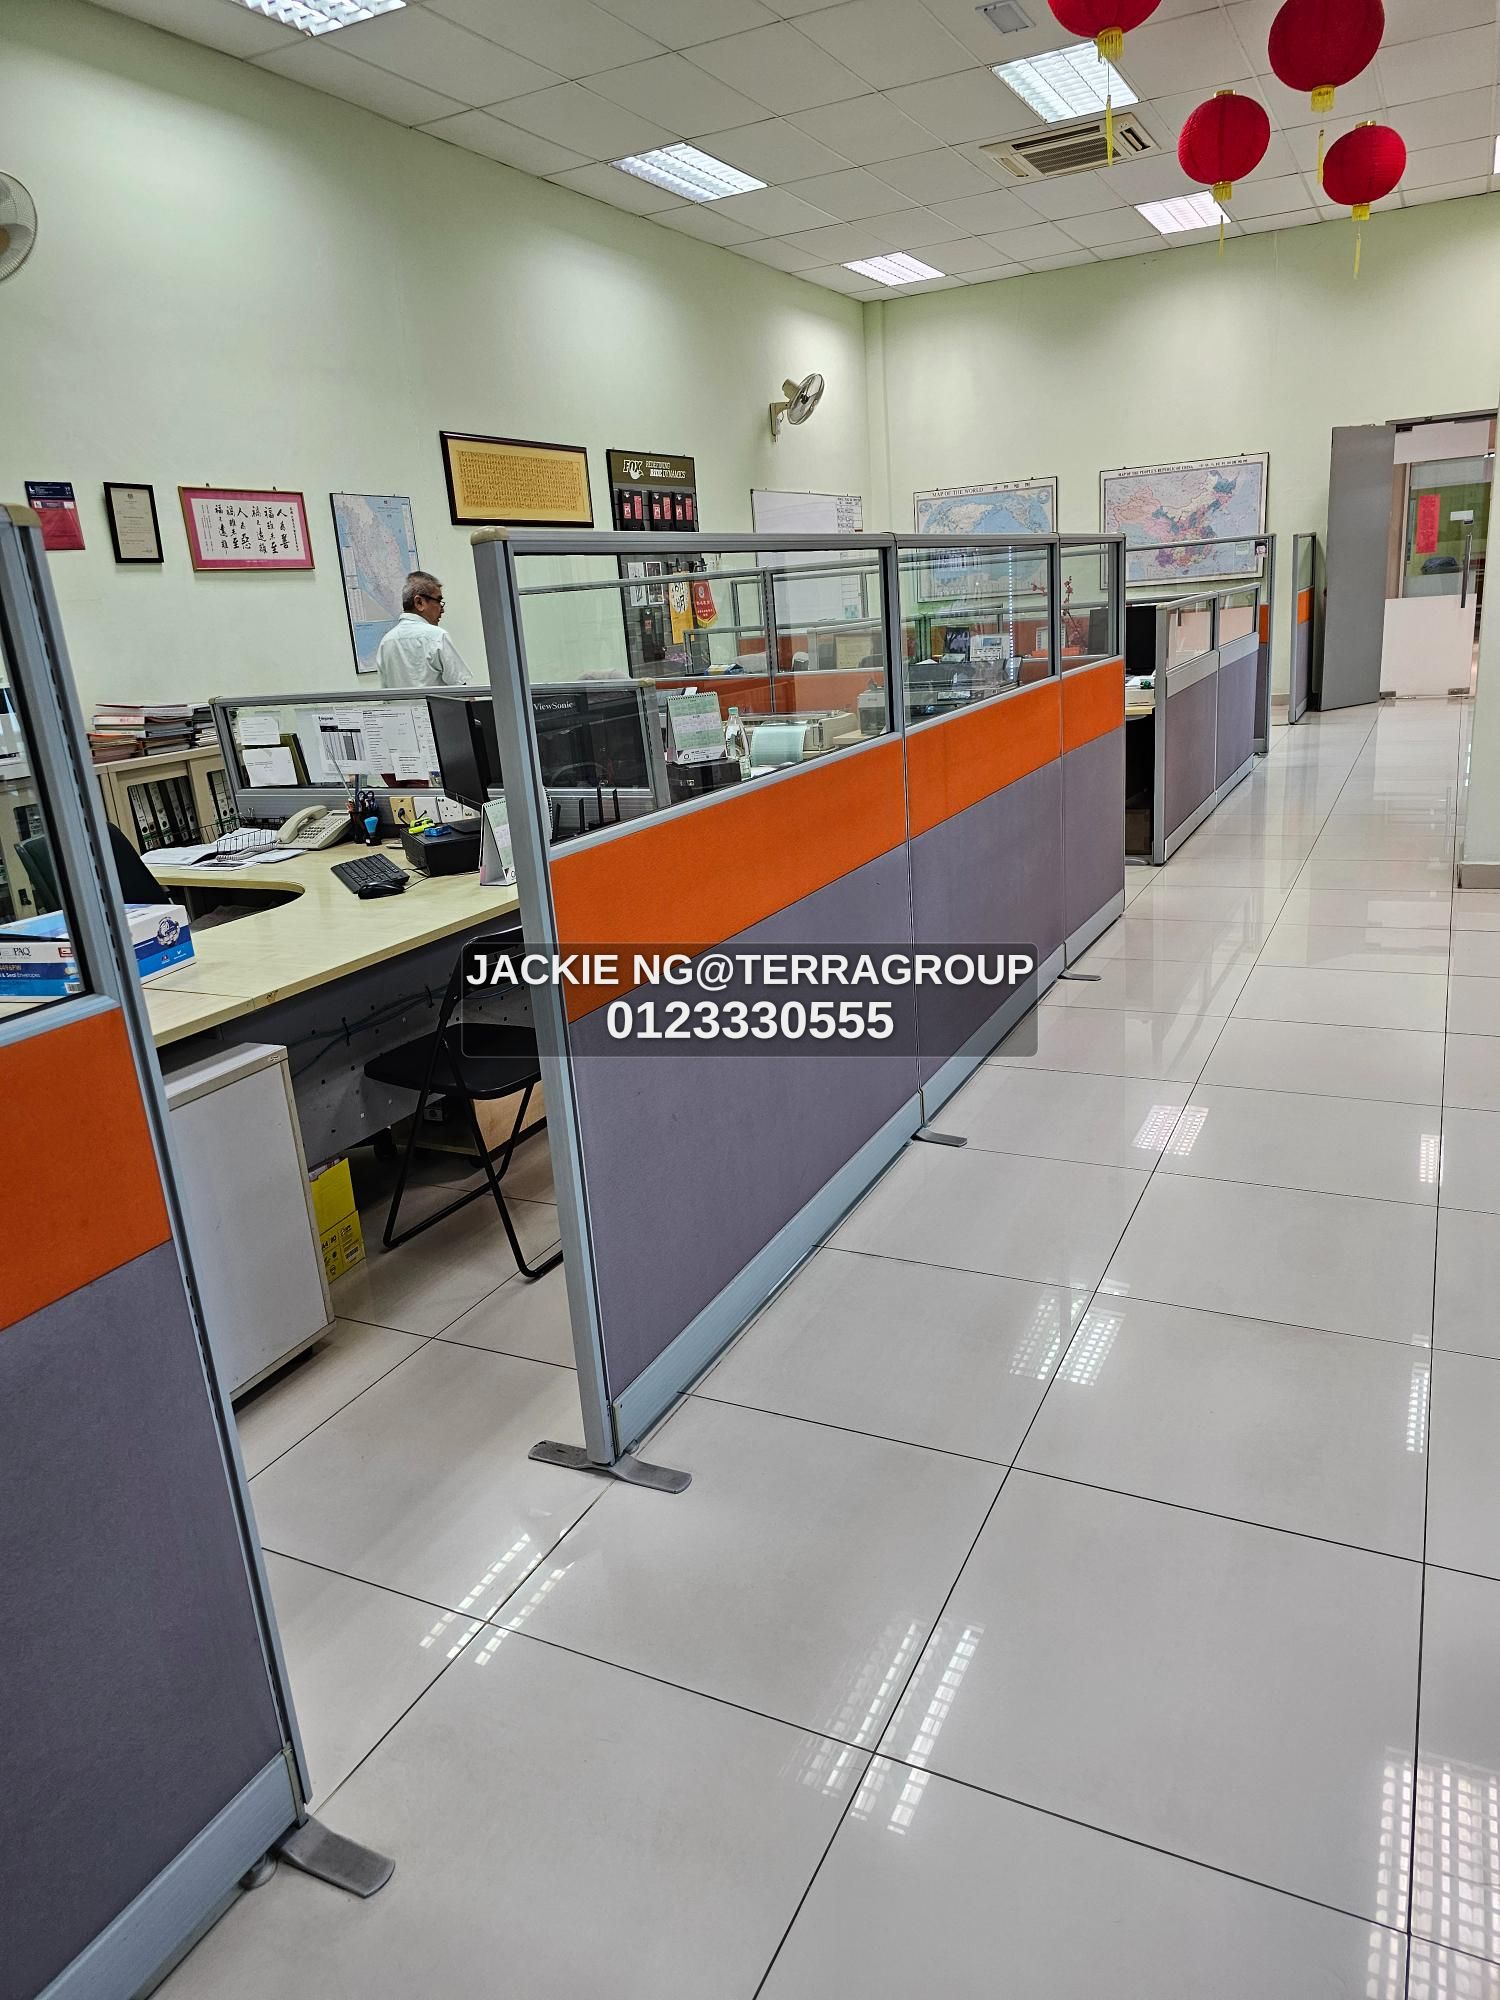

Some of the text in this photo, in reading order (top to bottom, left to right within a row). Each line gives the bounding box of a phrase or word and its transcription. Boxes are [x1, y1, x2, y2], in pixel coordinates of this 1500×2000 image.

[623, 459, 643, 475] FOX
[533, 700, 574, 710] ViewSonic
[13, 947, 32, 956] PAQ
